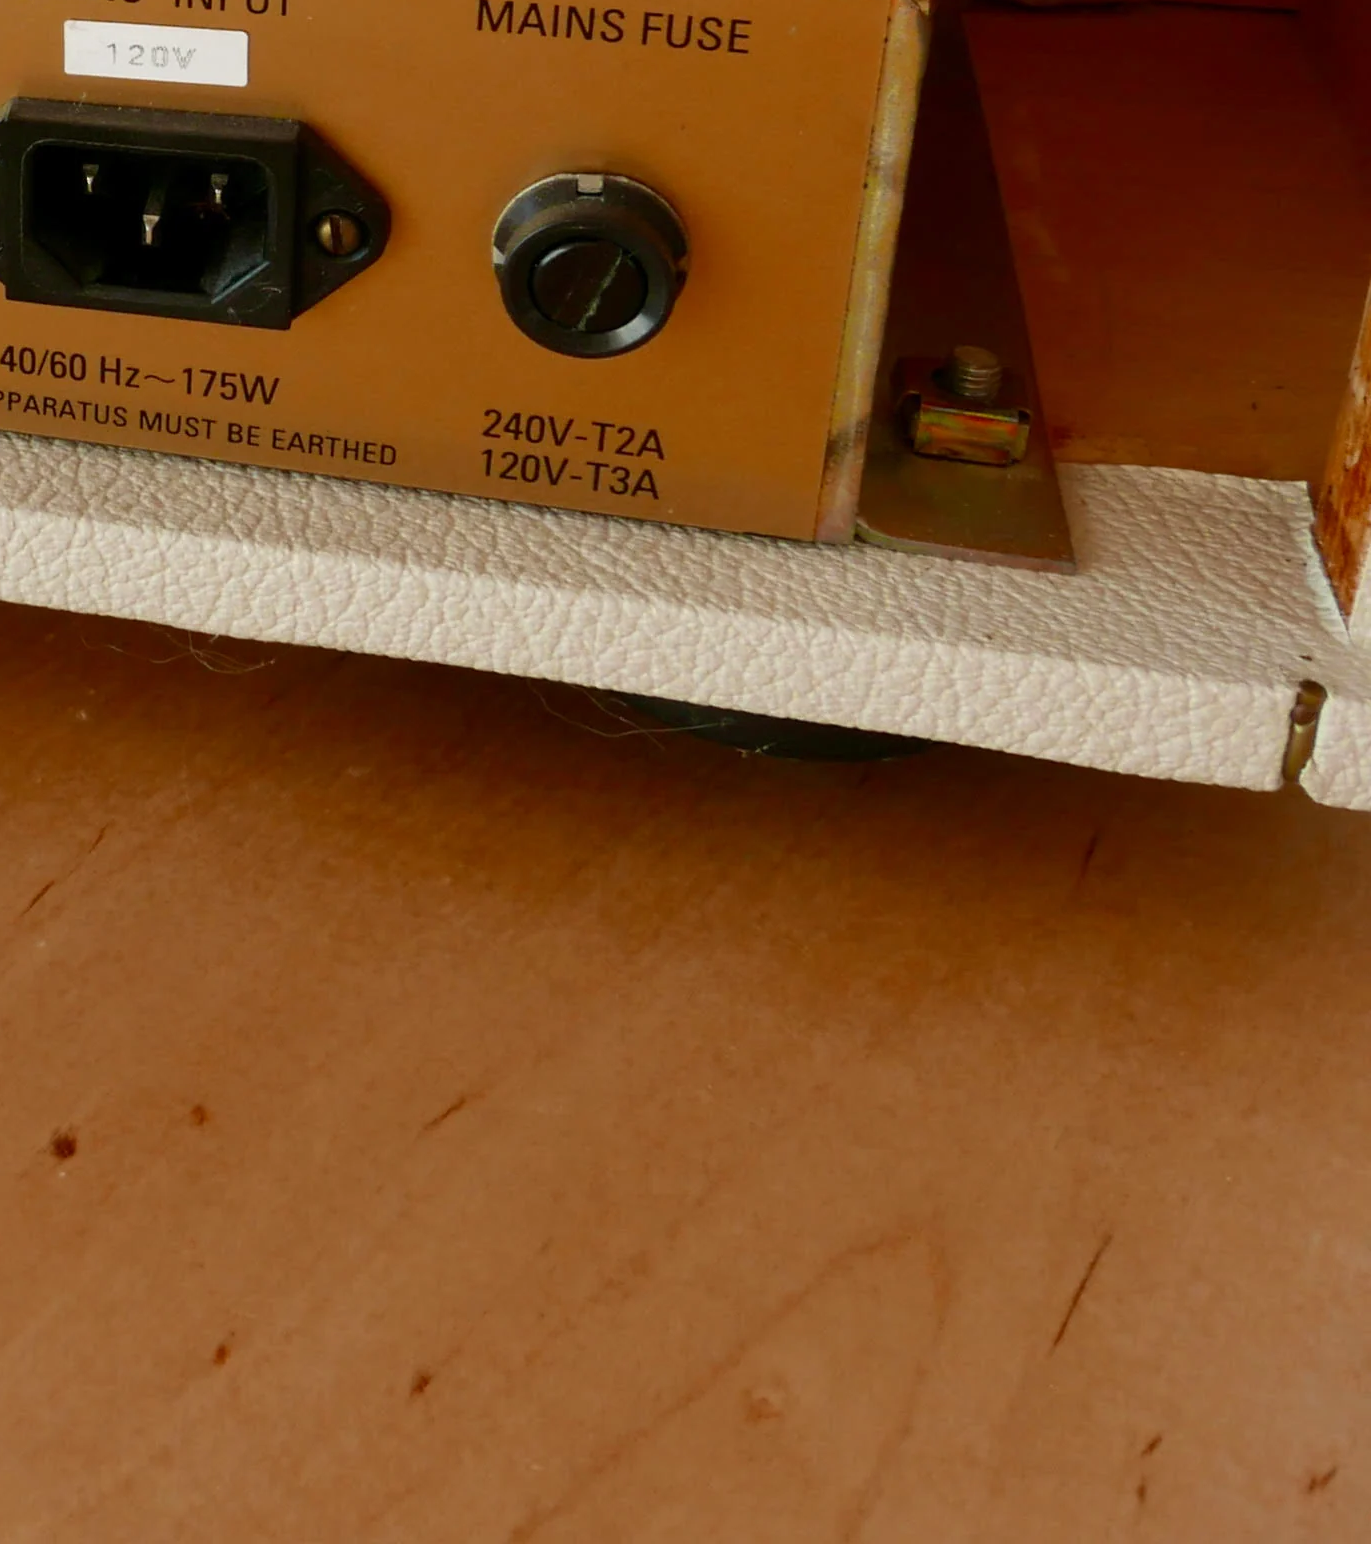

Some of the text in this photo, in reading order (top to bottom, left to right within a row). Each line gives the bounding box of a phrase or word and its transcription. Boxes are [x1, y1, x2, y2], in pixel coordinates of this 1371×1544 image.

[106, 42, 197, 70] 120V
[641, 11, 752, 54] FUSE
[0, 345, 87, 382] 40/60
[139, 409, 217, 441] MUST
[227, 421, 261, 447] BE
[271, 427, 398, 467] EARTHED
[481, 408, 665, 461] 240V-T2A
[480, 448, 660, 500] 120V-T3A
